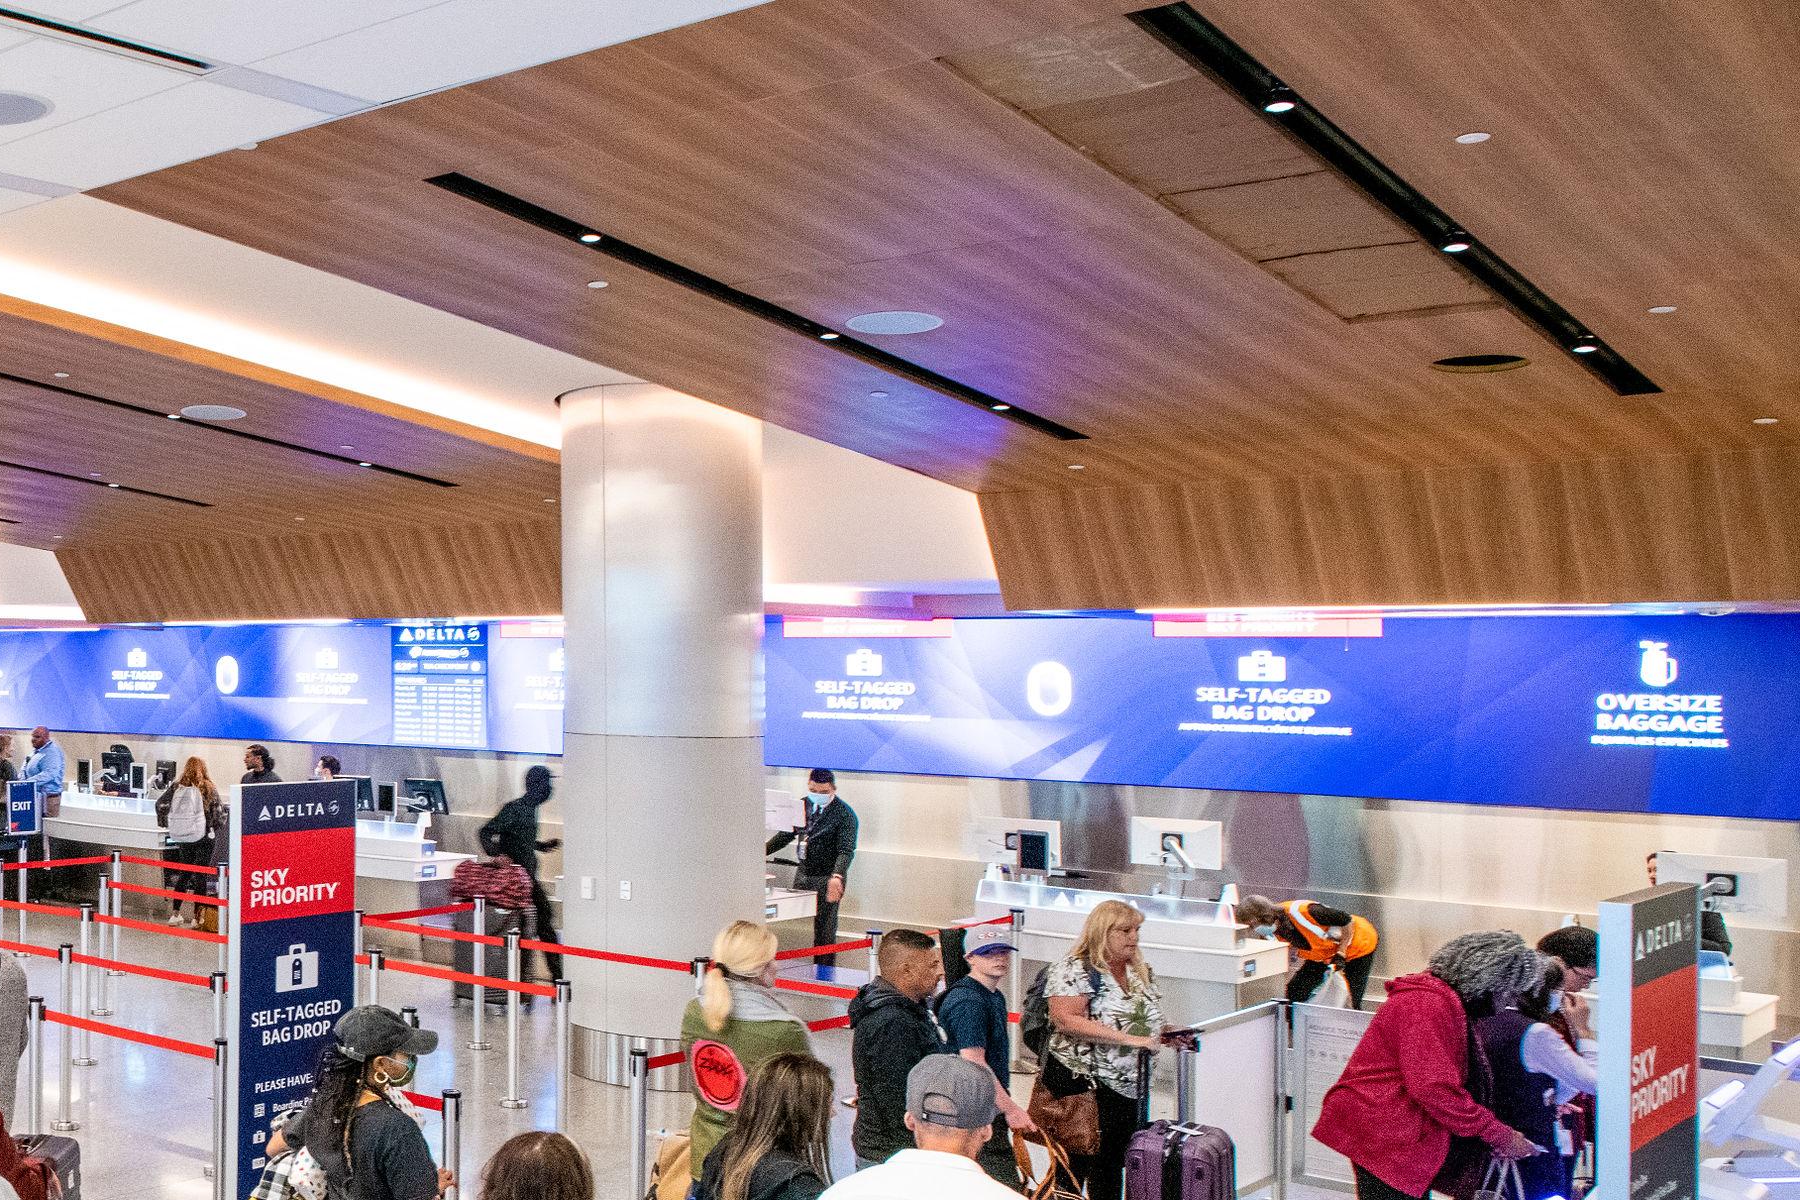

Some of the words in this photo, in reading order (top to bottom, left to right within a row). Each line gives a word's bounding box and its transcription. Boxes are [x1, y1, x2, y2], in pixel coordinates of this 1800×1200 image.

[414, 628, 466, 641] DELTA
[295, 672, 358, 684] SELF-TAGGED
[525, 676, 564, 688] SELF-T
[814, 680, 916, 696] SELF-TAGGED
[1195, 686, 1332, 705] SELF-TAGGED
[826, 696, 859, 710] BAG
[860, 697, 904, 711] DROP
[1596, 693, 1724, 713] OVERSIZE
[1212, 705, 1254, 721] BAG
[1256, 706, 1316, 722] DROP
[1596, 713, 1724, 733] BAGGAGE
[11, 801, 32, 811] EXIT
[275, 802, 325, 819] DELTA
[250, 868, 290, 889] SKY
[250, 882, 339, 909] PRIORITY
[1646, 917, 1683, 954] DELTA
[250, 999, 342, 1028] SELF-TAGGED
[262, 1023, 293, 1047] BAG
[293, 1020, 331, 1042] DROP
[1631, 1045, 1658, 1087] SKY
[254, 1076, 286, 1094] PLEASE
[286, 1073, 314, 1089] HAVE:
[1631, 1063, 1690, 1124] PRIORITY
[272, 1097, 303, 1114] Boarding
